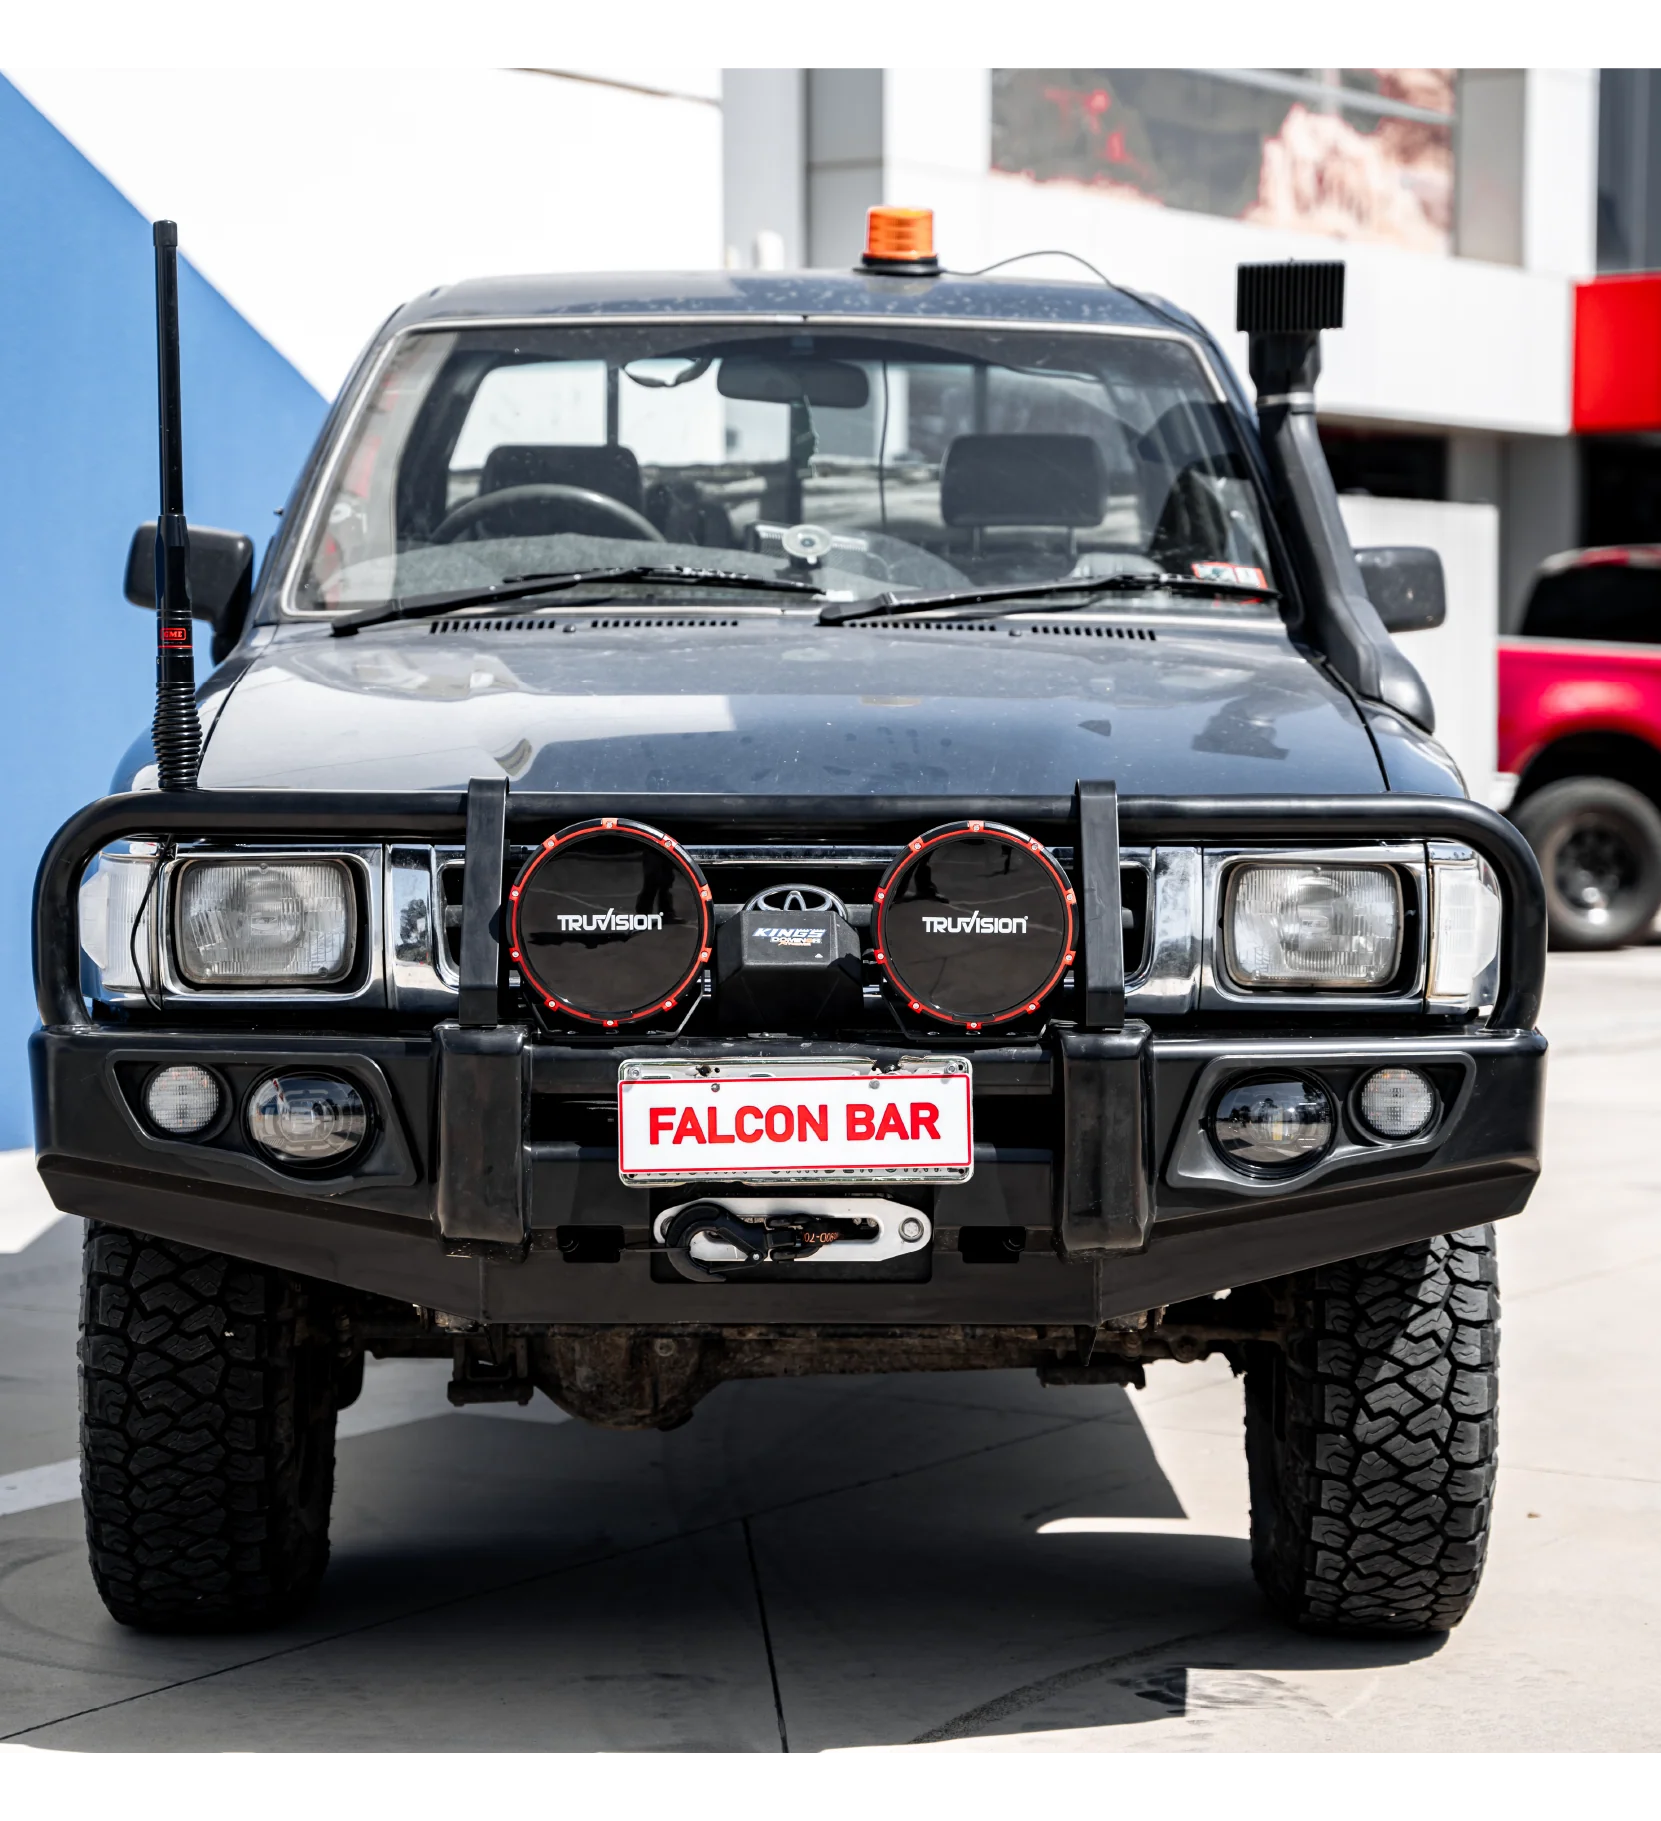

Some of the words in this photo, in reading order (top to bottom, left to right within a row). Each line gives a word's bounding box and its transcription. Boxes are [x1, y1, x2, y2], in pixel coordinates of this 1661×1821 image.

[557, 908, 664, 931] TRUVISION
[922, 910, 1029, 934] TRUVISION
[752, 927, 827, 938] KINGS
[649, 1104, 829, 1145] FALCON
[846, 1102, 941, 1141] BAR
